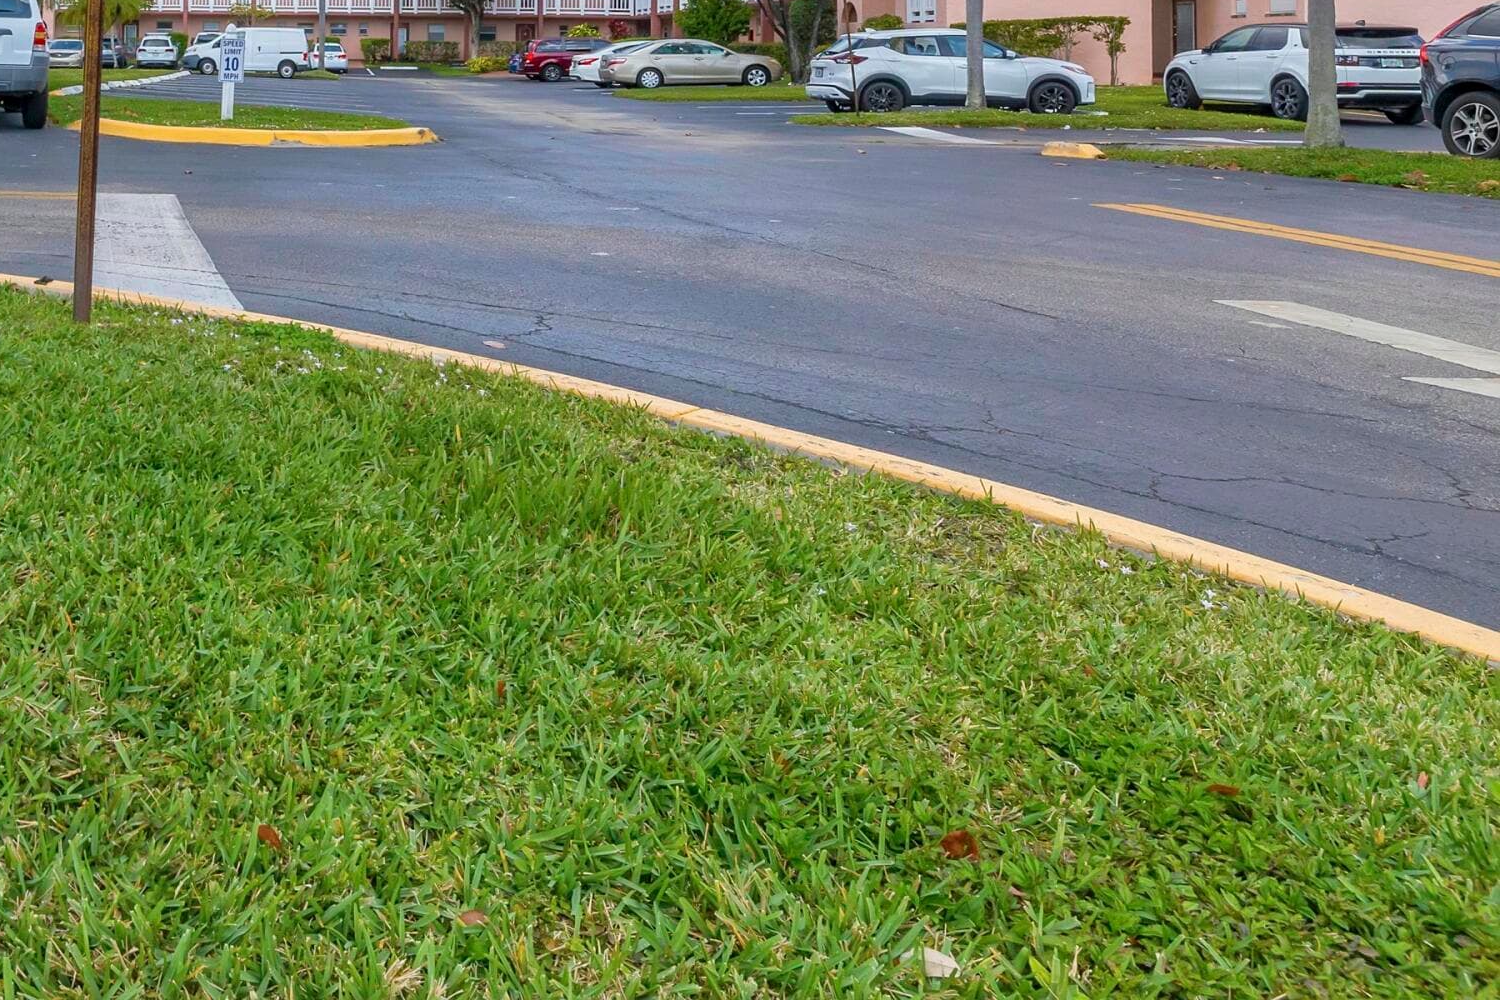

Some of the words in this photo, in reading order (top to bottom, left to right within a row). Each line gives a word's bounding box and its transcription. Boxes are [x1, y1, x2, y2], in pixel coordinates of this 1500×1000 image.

[223, 40, 244, 48] SPEED
[224, 56, 240, 72] 10
[223, 72, 240, 80] MPH
